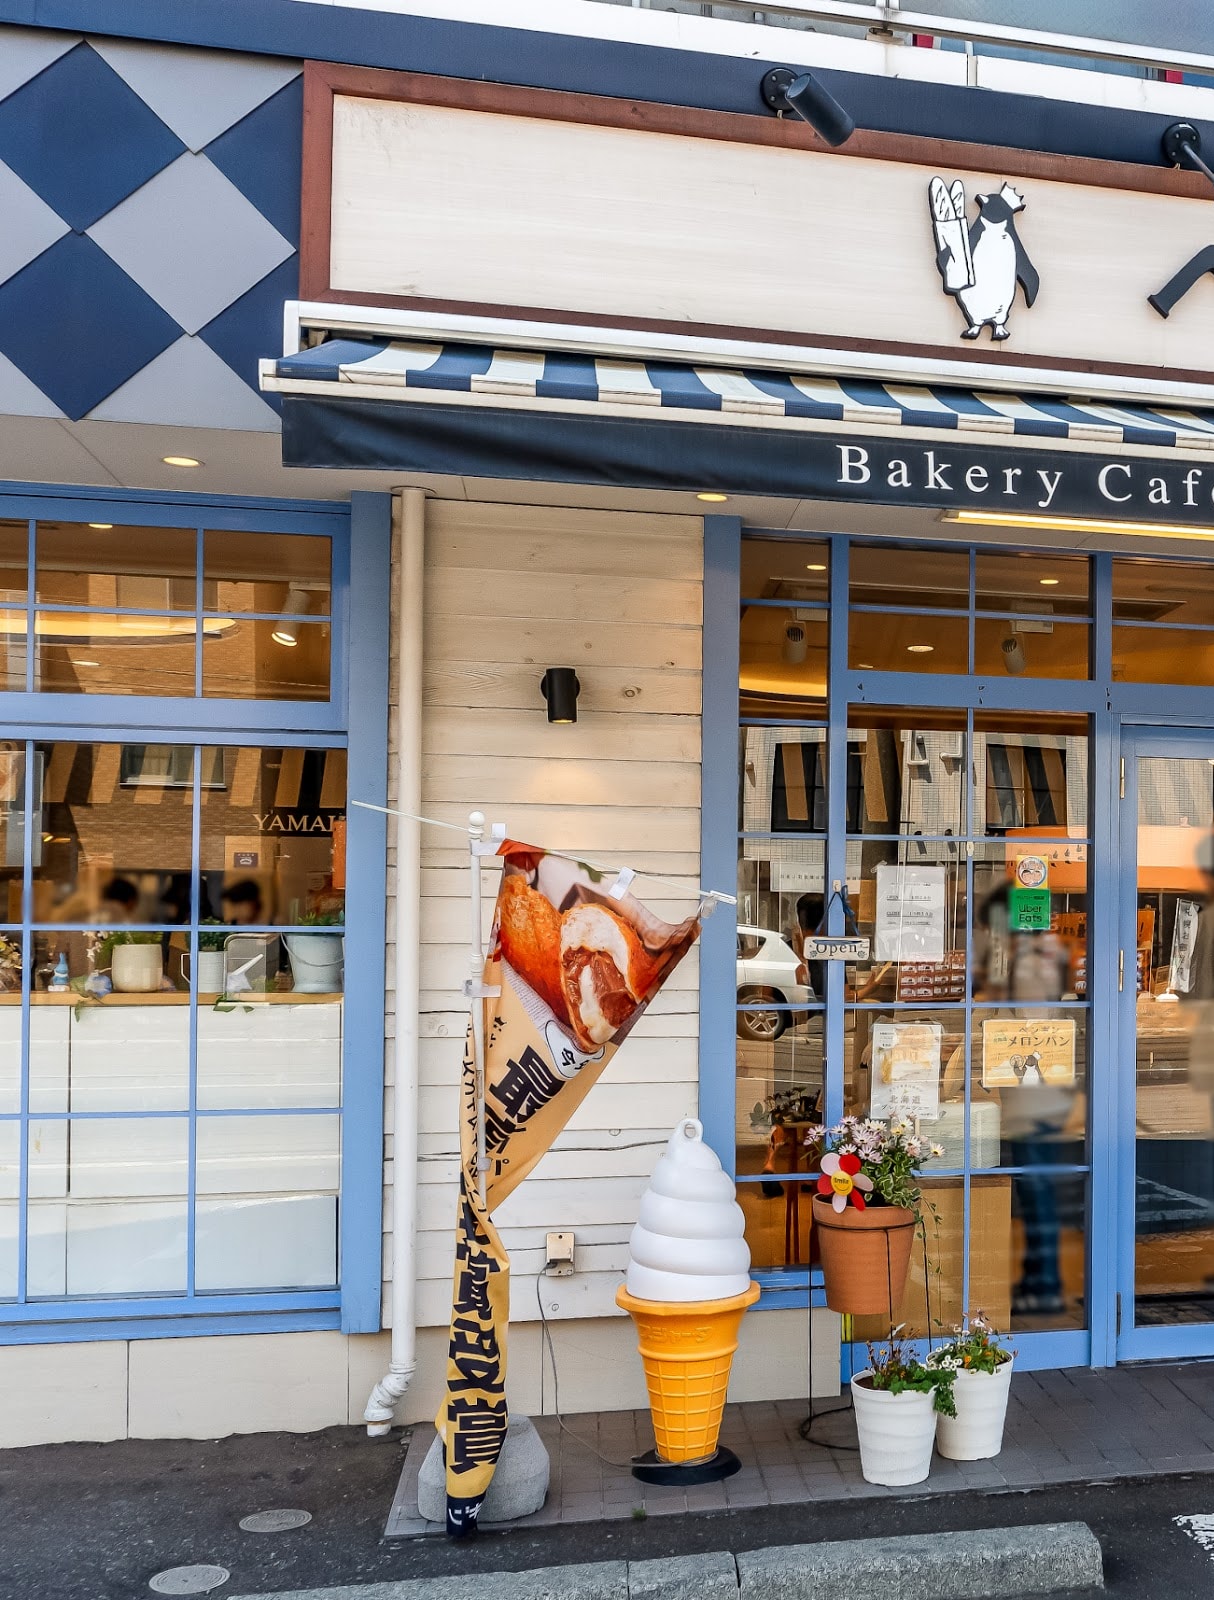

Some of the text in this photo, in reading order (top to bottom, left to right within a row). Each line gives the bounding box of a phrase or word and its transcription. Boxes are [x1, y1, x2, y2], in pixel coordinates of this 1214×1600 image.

[836, 444, 1063, 507] Bakery
[1018, 904, 1042, 913] Uber
[1018, 913, 1043, 923] Eats
[816, 942, 859, 956] Open
[1008, 1036, 1070, 1047] メロンパン
